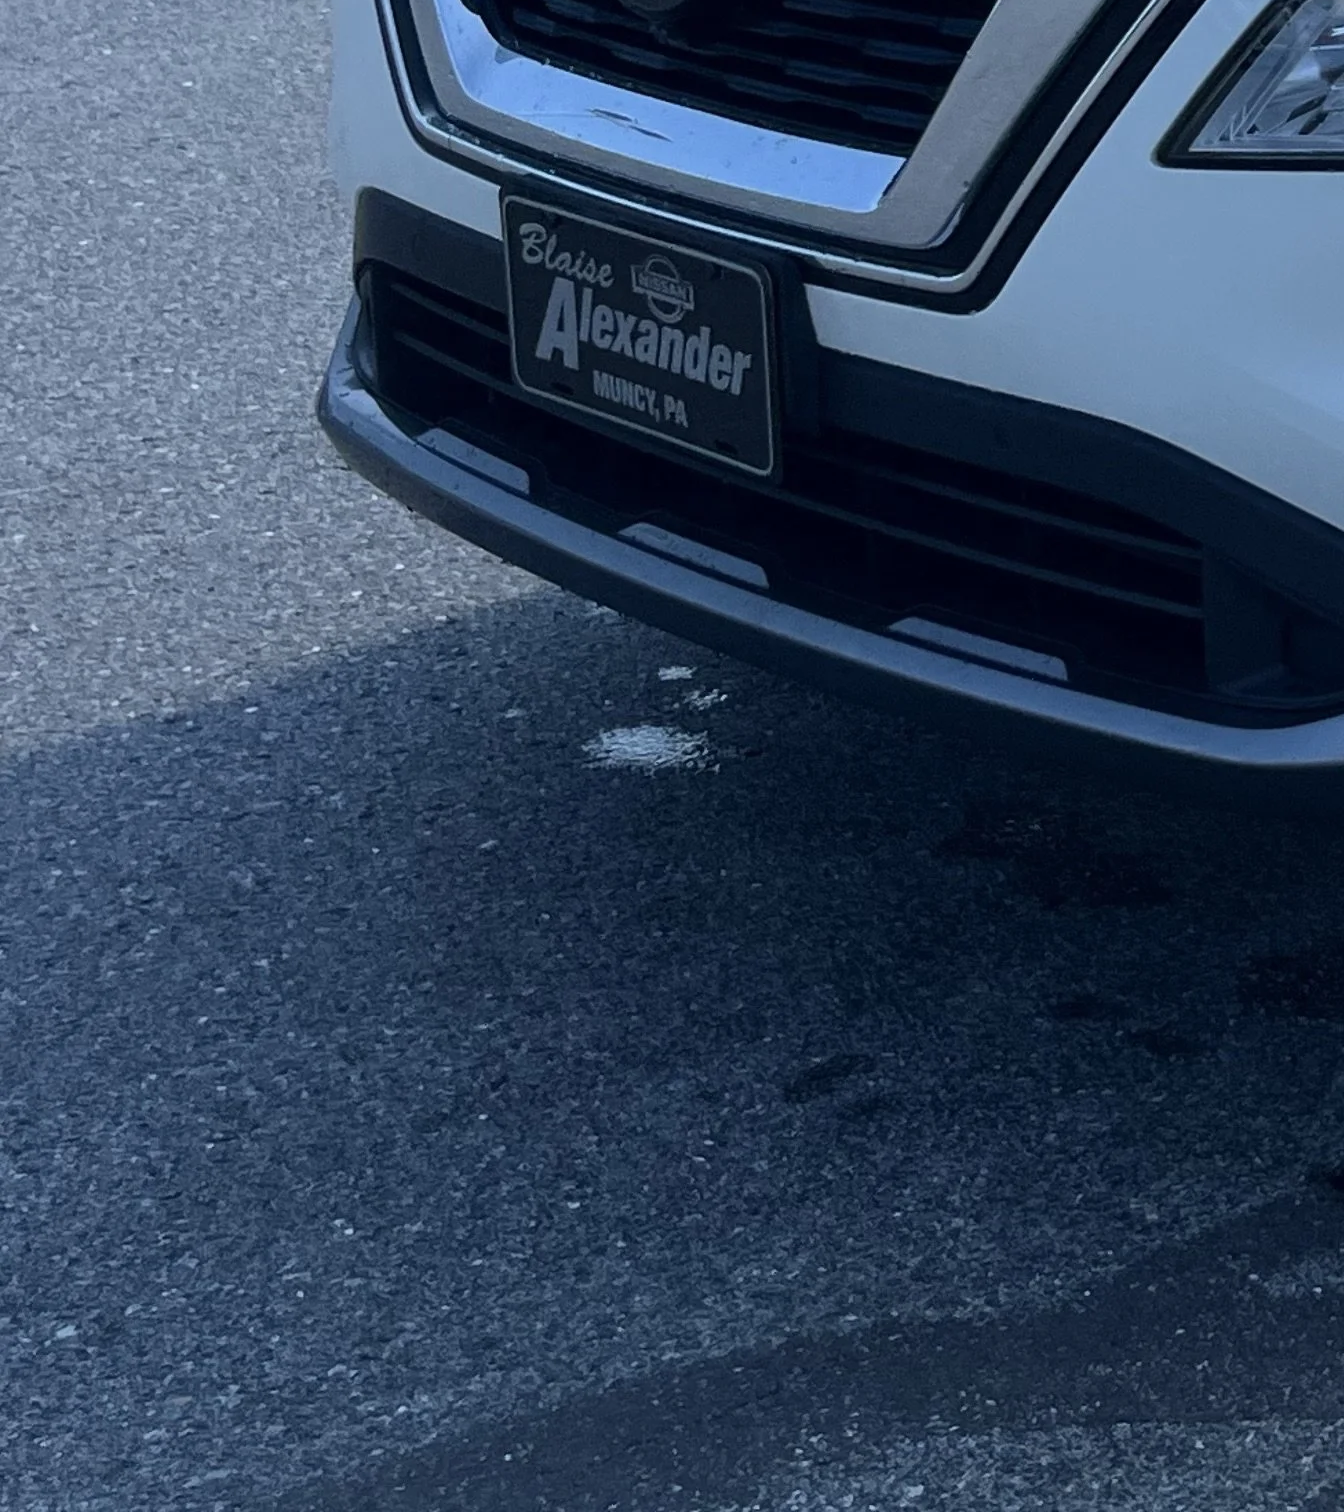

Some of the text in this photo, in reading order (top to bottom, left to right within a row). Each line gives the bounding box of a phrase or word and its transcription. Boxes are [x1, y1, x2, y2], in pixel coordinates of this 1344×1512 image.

[519, 222, 614, 288] Blaise
[535, 276, 752, 396] Alexander
[593, 369, 689, 428] MUNCY, PA
